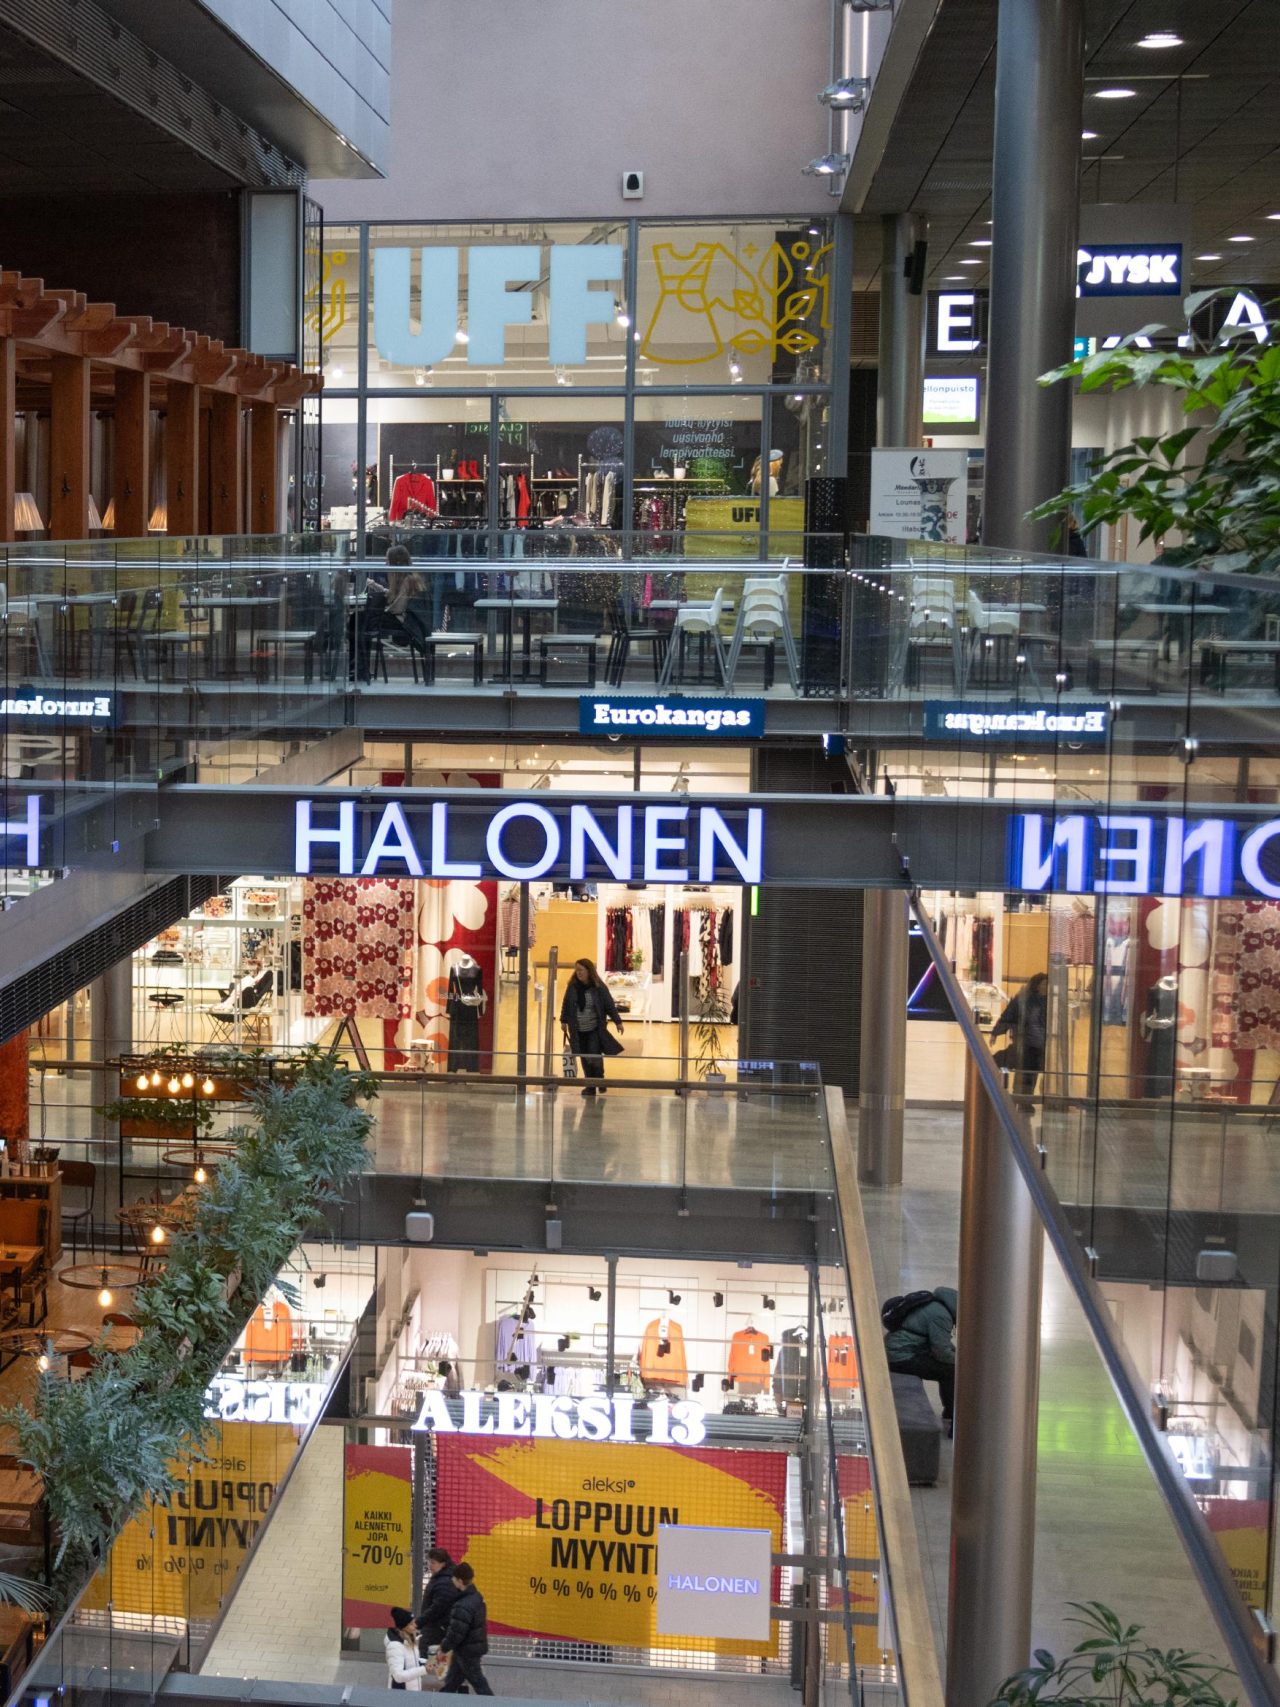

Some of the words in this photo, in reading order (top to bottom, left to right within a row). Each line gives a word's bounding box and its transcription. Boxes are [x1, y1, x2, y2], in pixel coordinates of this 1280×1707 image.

[1086, 254, 1178, 284] JYSK
[373, 245, 624, 366] UFF
[922, 385, 975, 393] ellonpuisto
[594, 704, 751, 730] Eurokangas
[295, 800, 764, 883] HALONEN
[411, 1390, 636, 1442] ALEKSI
[646, 1399, 706, 1446] 13
[364, 1511, 392, 1521] KAIKKI
[354, 1521, 404, 1534] ALENNETTU,
[367, 1532, 388, 1542] JOPA
[352, 1545, 403, 1566] -70%
[668, 1575, 758, 1594] HALONEN
